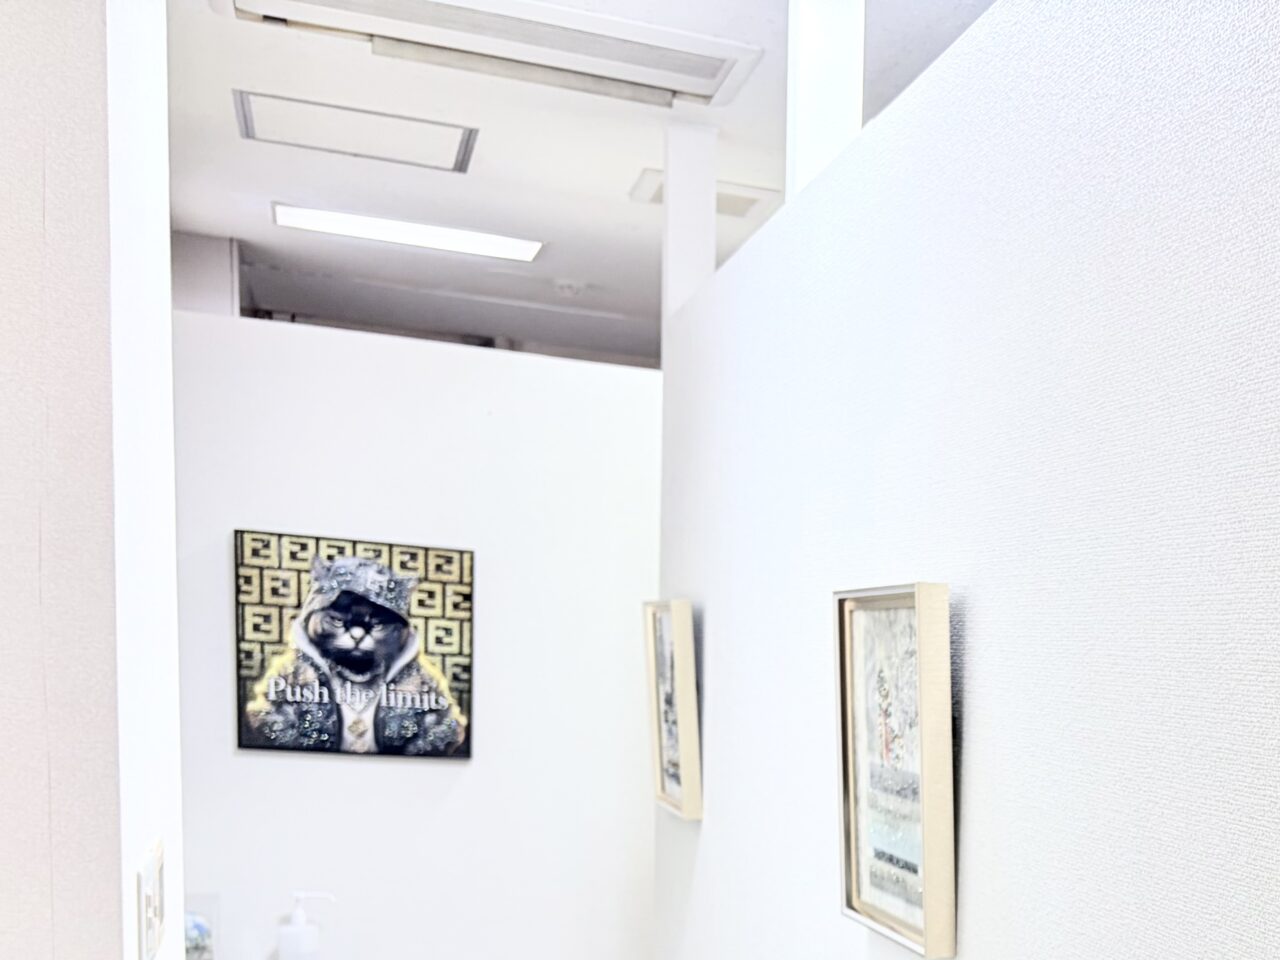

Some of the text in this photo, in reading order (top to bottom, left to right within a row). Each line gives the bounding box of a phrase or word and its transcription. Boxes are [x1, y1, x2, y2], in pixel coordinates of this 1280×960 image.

[268, 676, 449, 711] Push the limits
